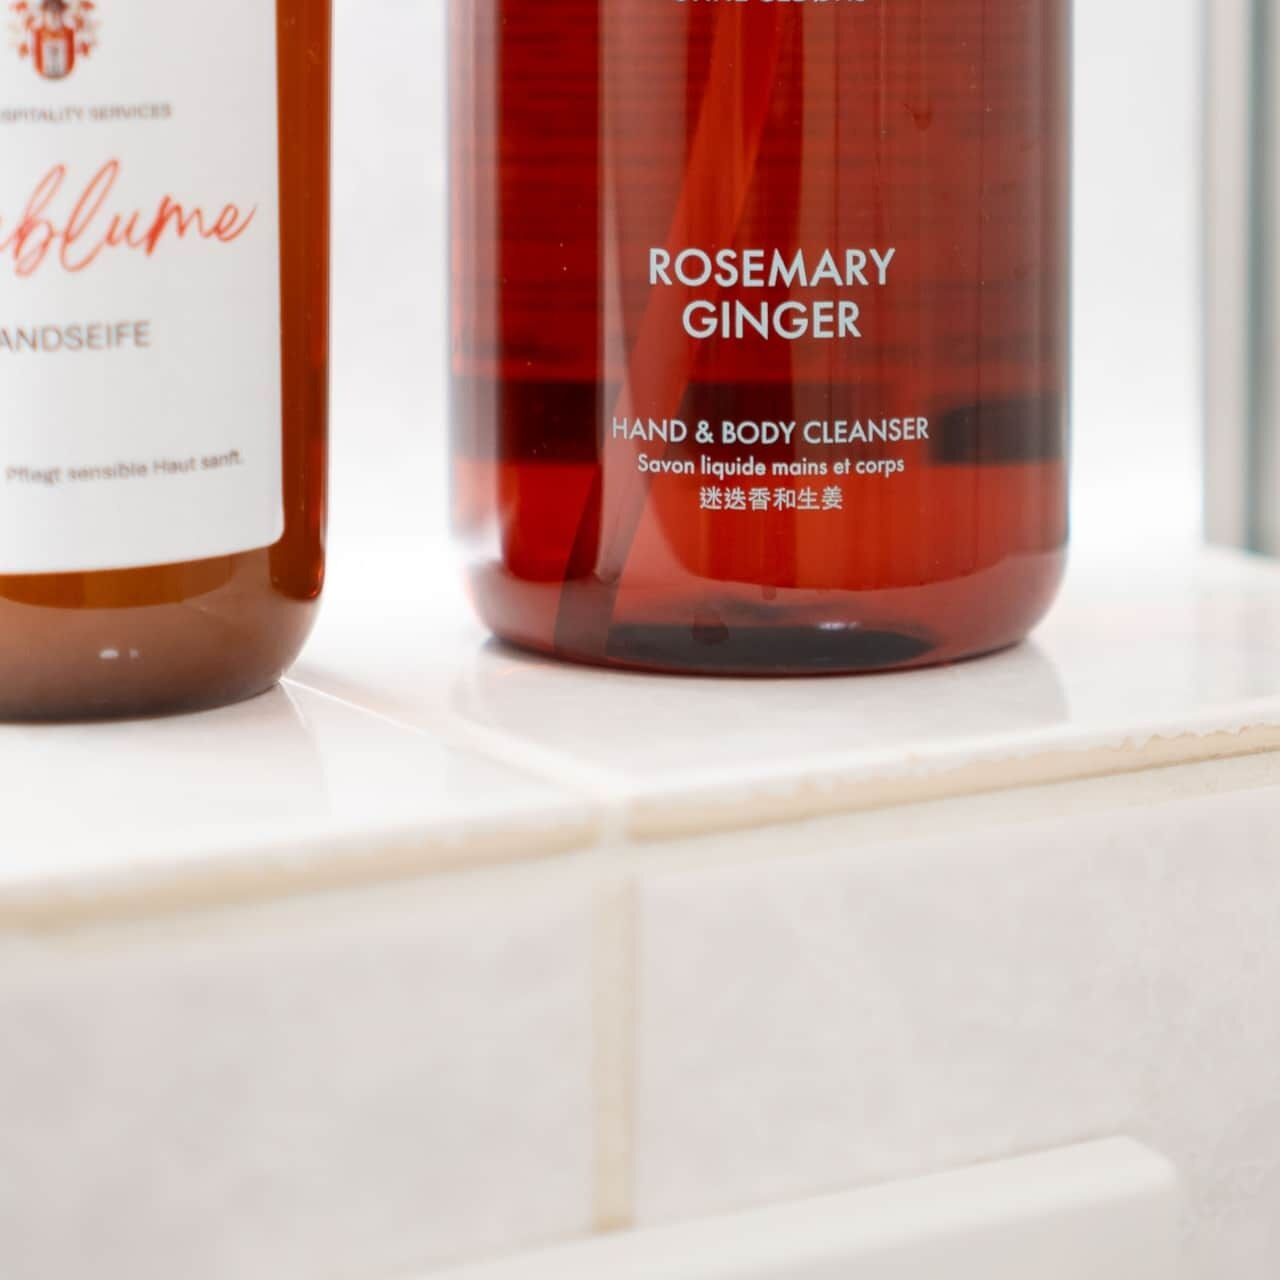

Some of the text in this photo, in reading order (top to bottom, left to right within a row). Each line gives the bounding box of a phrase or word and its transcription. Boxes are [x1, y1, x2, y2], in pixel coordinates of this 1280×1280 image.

[88, 102, 173, 122] SERVICES
[648, 247, 896, 289] ROSEMARY
[682, 299, 862, 340] GINGER
[612, 417, 930, 445] HAND & BODY CLEANSER
[69, 461, 148, 481] sensible
[153, 457, 196, 476] Haut
[637, 453, 905, 480] Savon liquide mains et corps
[699, 484, 844, 511] 迷迭香和生姜
